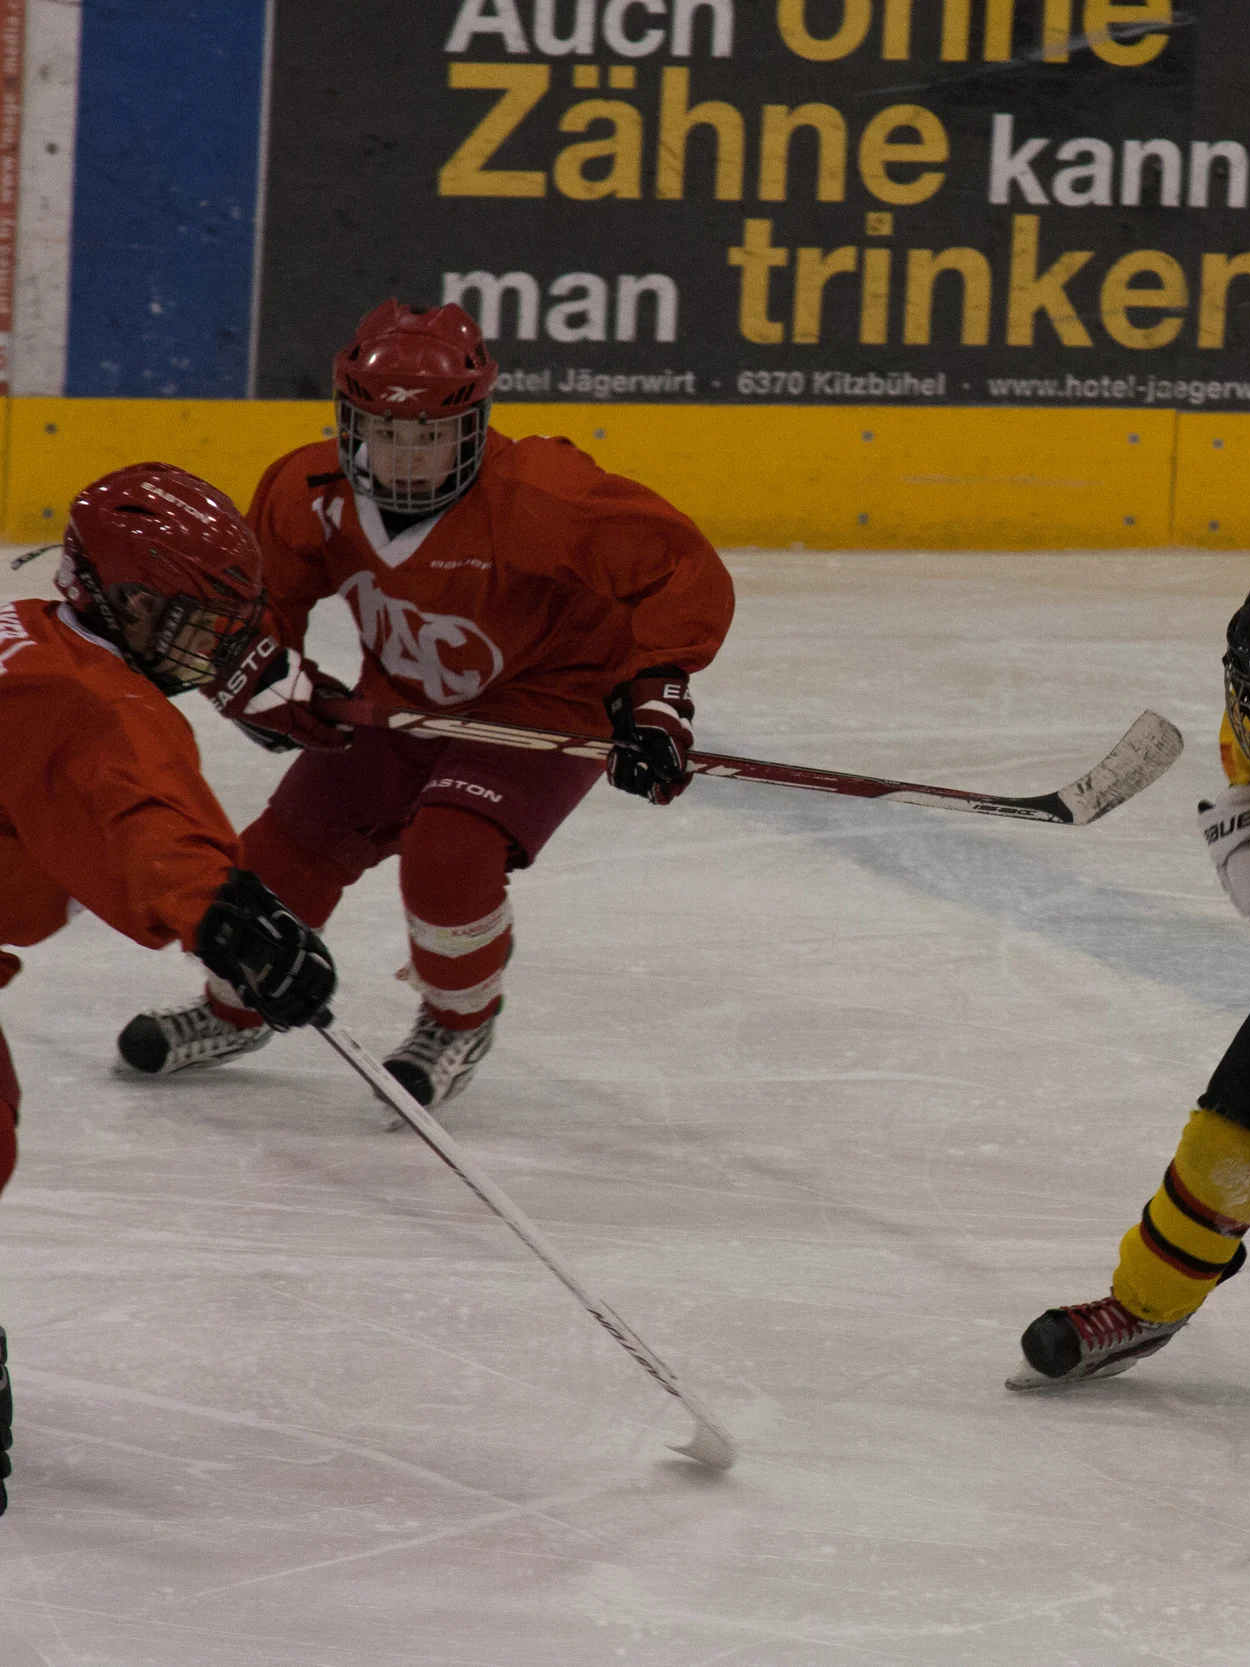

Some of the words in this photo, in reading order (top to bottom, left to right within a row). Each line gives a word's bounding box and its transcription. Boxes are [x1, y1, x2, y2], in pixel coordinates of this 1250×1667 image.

[444, 0, 733, 57] Auch
[437, 62, 949, 204] Zähne
[988, 113, 1249, 207] kann
[441, 271, 678, 342] man
[497, 371, 549, 392] otel
[557, 369, 695, 398] Jägerwirt
[737, 371, 804, 395] 6370
[813, 371, 947, 396] Kitzbühel
[140, 482, 211, 525] EASTON
[421, 777, 504, 803] ASTON
